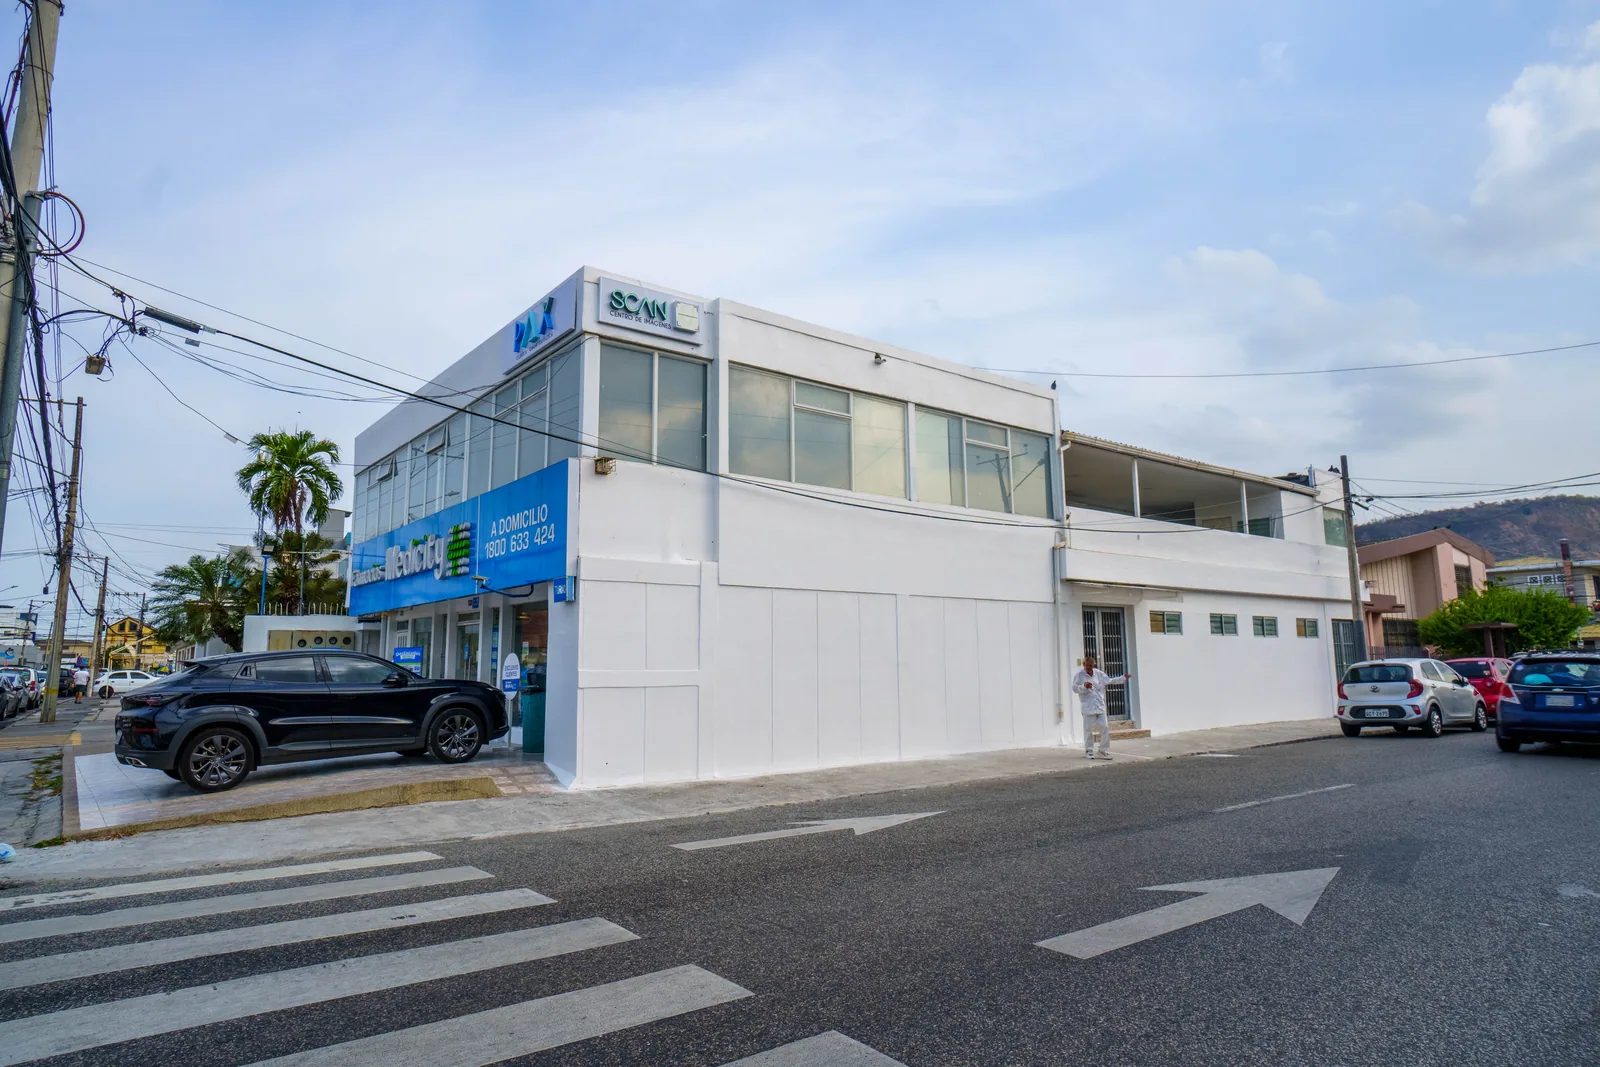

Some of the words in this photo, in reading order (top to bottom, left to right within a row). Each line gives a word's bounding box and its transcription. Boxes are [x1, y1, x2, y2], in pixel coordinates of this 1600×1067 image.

[609, 310, 634, 321] CENTRO
[635, 315, 642, 323] DE
[610, 289, 667, 321] SCAN
[490, 521, 497, 538] A
[499, 504, 548, 535] DOMICILIO
[484, 537, 507, 559] 1800
[510, 531, 529, 553] 633
[533, 523, 555, 546] 424
